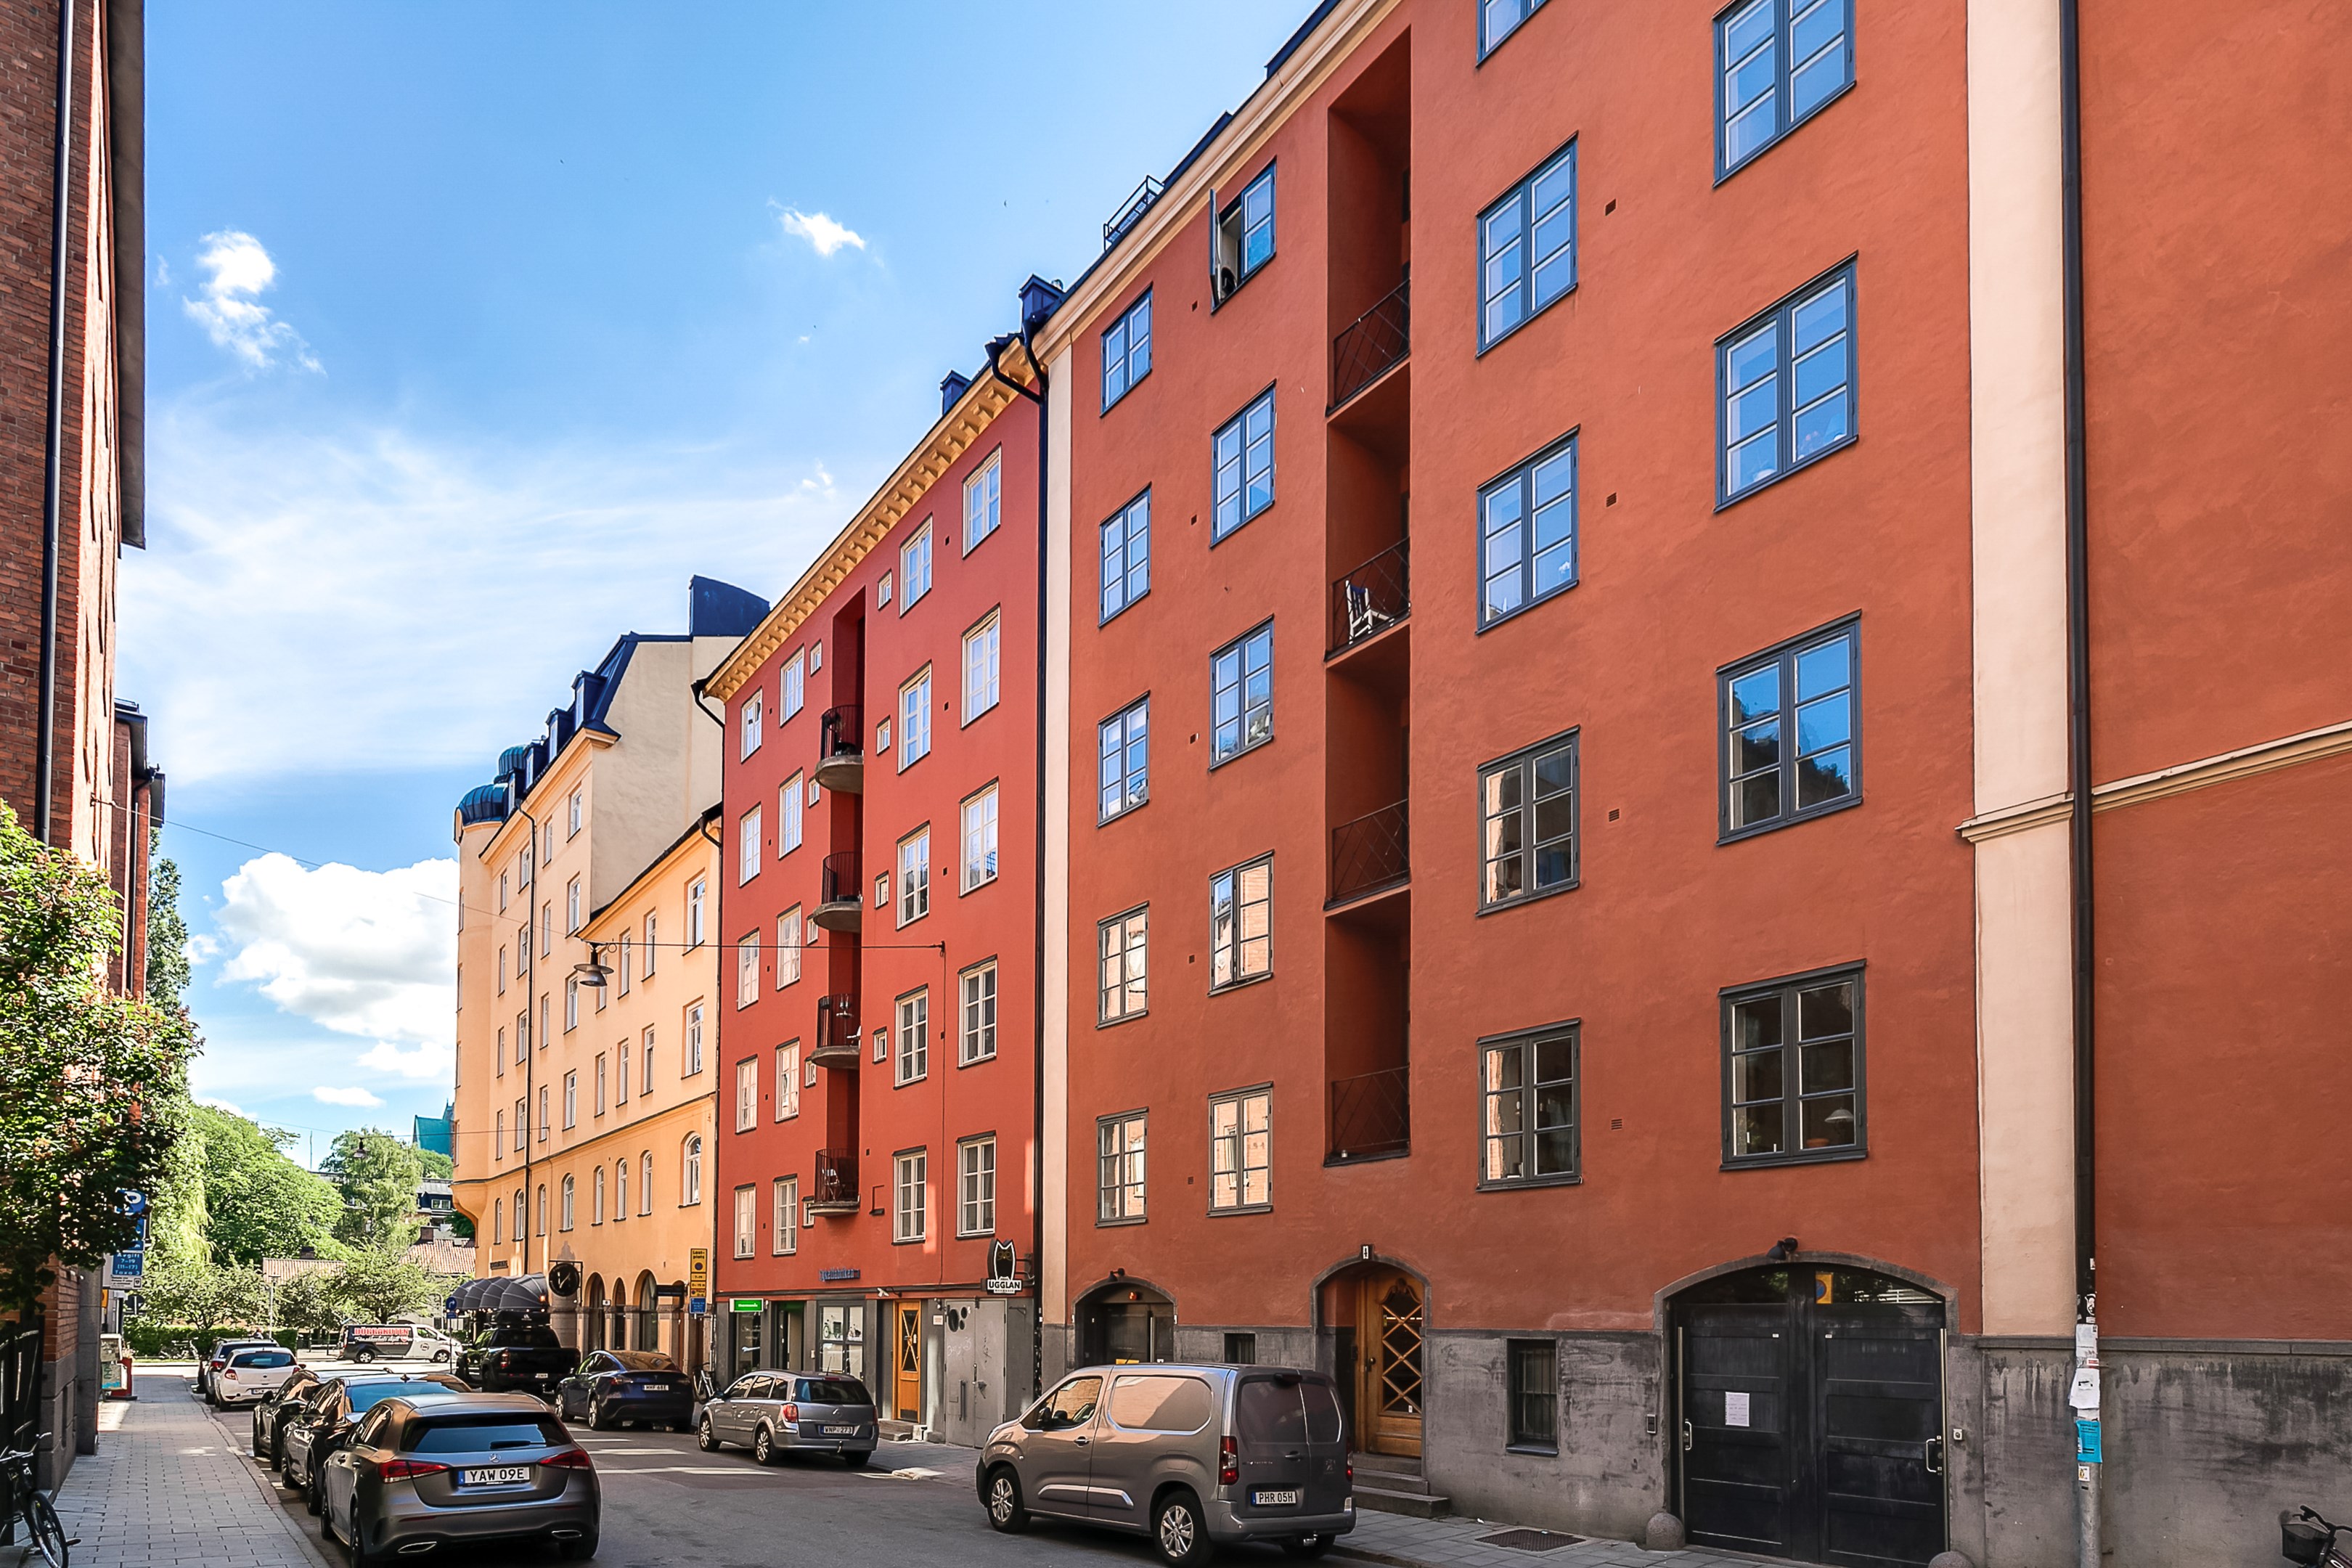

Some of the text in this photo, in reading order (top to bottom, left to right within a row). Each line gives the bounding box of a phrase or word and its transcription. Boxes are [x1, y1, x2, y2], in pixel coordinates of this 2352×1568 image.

[470, 1469, 524, 1482] YAW 09E
[1259, 1493, 1293, 1503] PHR 05H
